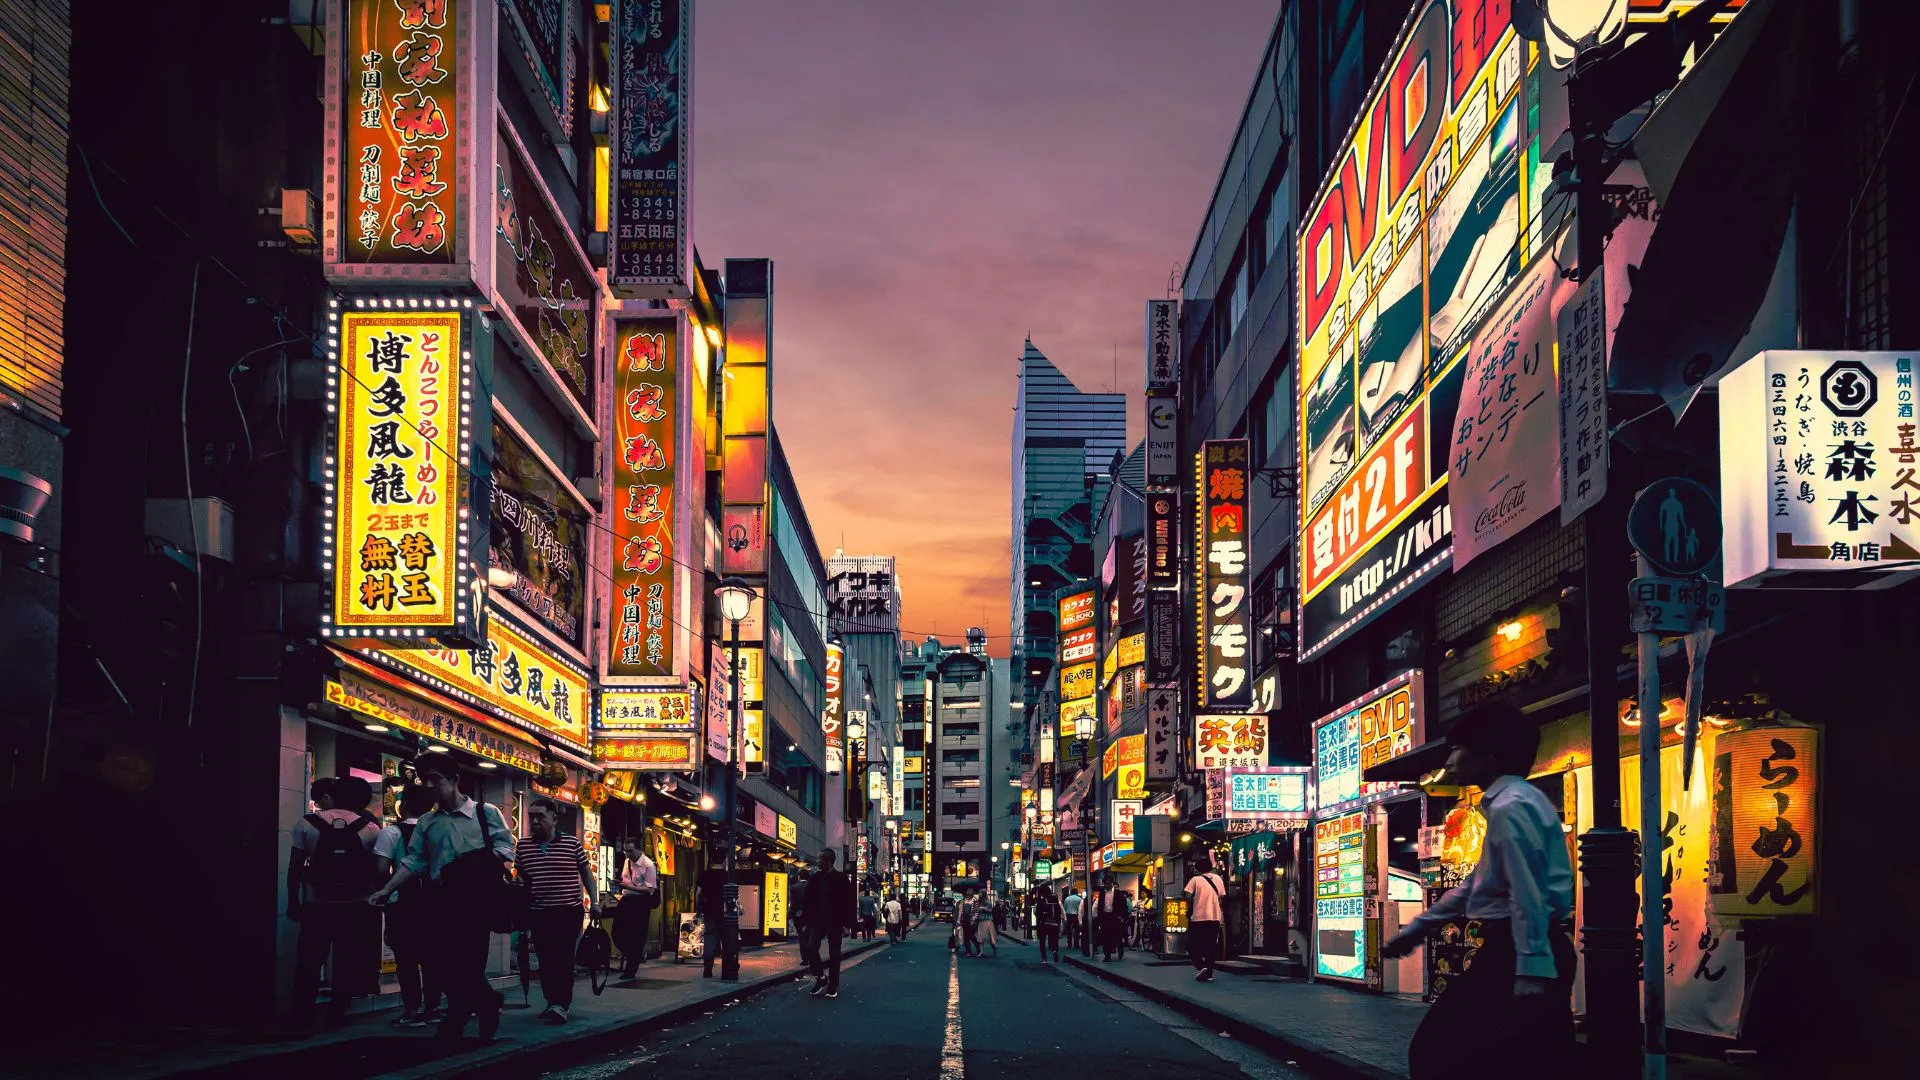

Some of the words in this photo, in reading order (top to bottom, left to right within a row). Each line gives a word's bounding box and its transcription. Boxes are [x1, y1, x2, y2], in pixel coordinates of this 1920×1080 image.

[360, 51, 382, 128] 中国料理
[621, 169, 677, 180] 新宿東口店
[631, 197, 673, 208] 3341
[620, 225, 676, 239] 五反田店
[631, 253, 674, 264] 3444
[1478, 331, 1520, 396] 渋谷
[1896, 358, 1914, 418] 信州の酒
[363, 331, 414, 506] 博多風龍
[416, 332, 441, 506] とんこつらーめん
[1456, 342, 1541, 446] おとなり
[1573, 299, 1592, 500] 防犯カメラ作動中
[1455, 389, 1545, 479] サンデー
[1794, 367, 1816, 505] うなぎ・焼鳥
[1832, 421, 1868, 438] 渋谷
[1209, 468, 1244, 534] 焼肉
[1313, 421, 1417, 580] 受付2F
[1824, 440, 1880, 531] 森本
[366, 512, 429, 532] 2玉まで
[359, 533, 397, 612] 無料
[399, 532, 437, 606] 替玉
[1155, 544, 1167, 567] One
[1829, 541, 1880, 561] 角店
[621, 583, 642, 666] 中国料理
[646, 582, 664, 666] 刀削麺・餃子
[1064, 596, 1094, 611] カラオケ
[1208, 540, 1248, 700] モクモク
[1064, 632, 1093, 646] カラオケ
[467, 639, 572, 724] 博多風龍
[659, 696, 684, 709] 替玉
[824, 652, 842, 732] カラオケ
[1064, 668, 1094, 684] 腹八分目
[605, 706, 657, 719] 博多風龍
[1198, 717, 1266, 756] 英鮨
[1318, 718, 1347, 753] 金太郎
[1360, 690, 1409, 746] DVD
[1218, 757, 1260, 767] 道玄坂店
[1234, 776, 1267, 792] 金太郎
[1319, 741, 1358, 778] 渋谷書店
[1234, 794, 1279, 809] 渋谷書店
[1746, 737, 1811, 906] らーめん
[1317, 898, 1362, 917] 金太郎渋谷書店
